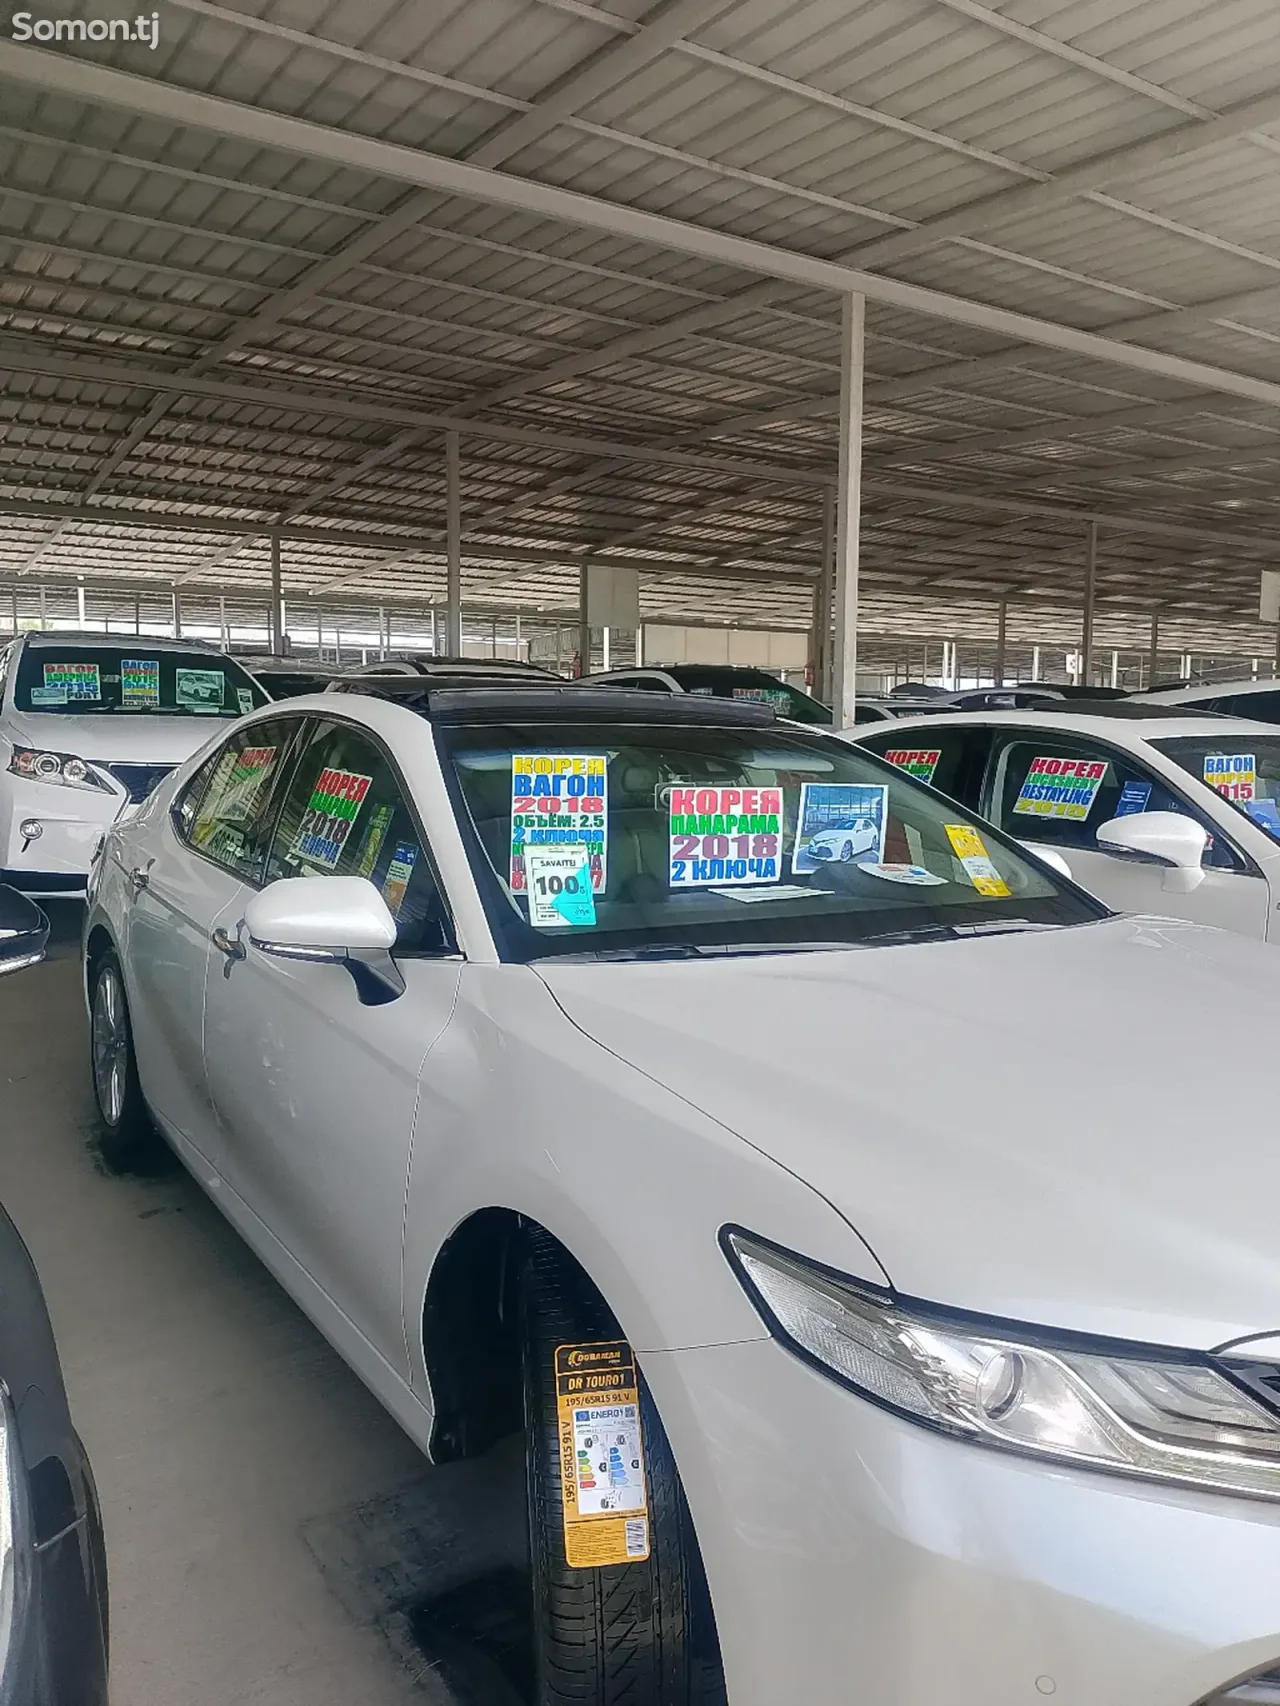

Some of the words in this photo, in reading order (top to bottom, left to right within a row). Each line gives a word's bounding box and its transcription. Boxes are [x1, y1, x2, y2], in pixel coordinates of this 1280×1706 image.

[513, 757, 605, 775] КОРЕЯ
[1030, 758, 1106, 779] КОРЕЯ
[1206, 757, 1253, 772] ВАГОН
[315, 769, 370, 803] КОРЕЯ
[513, 774, 605, 797] ВАГОН
[1216, 783, 1253, 799] 015
[513, 797, 604, 813] 2018
[671, 789, 780, 814] КОРЕЯ
[300, 808, 351, 844] 2018
[579, 815, 604, 828] 2.5
[671, 814, 779, 835] ПАНАРАМА
[513, 826, 526, 842] 2
[672, 834, 778, 860] 2018
[671, 861, 686, 881] 2
[692, 858, 776, 881] КЛЮЧА
[536, 875, 579, 896] 100
[568, 1378, 583, 1390] DR
[565, 1394, 611, 1407] 195/65R15
[561, 1421, 571, 1429] V
[562, 1430, 572, 1444] 91
[563, 1445, 576, 1504] 195/65R15
